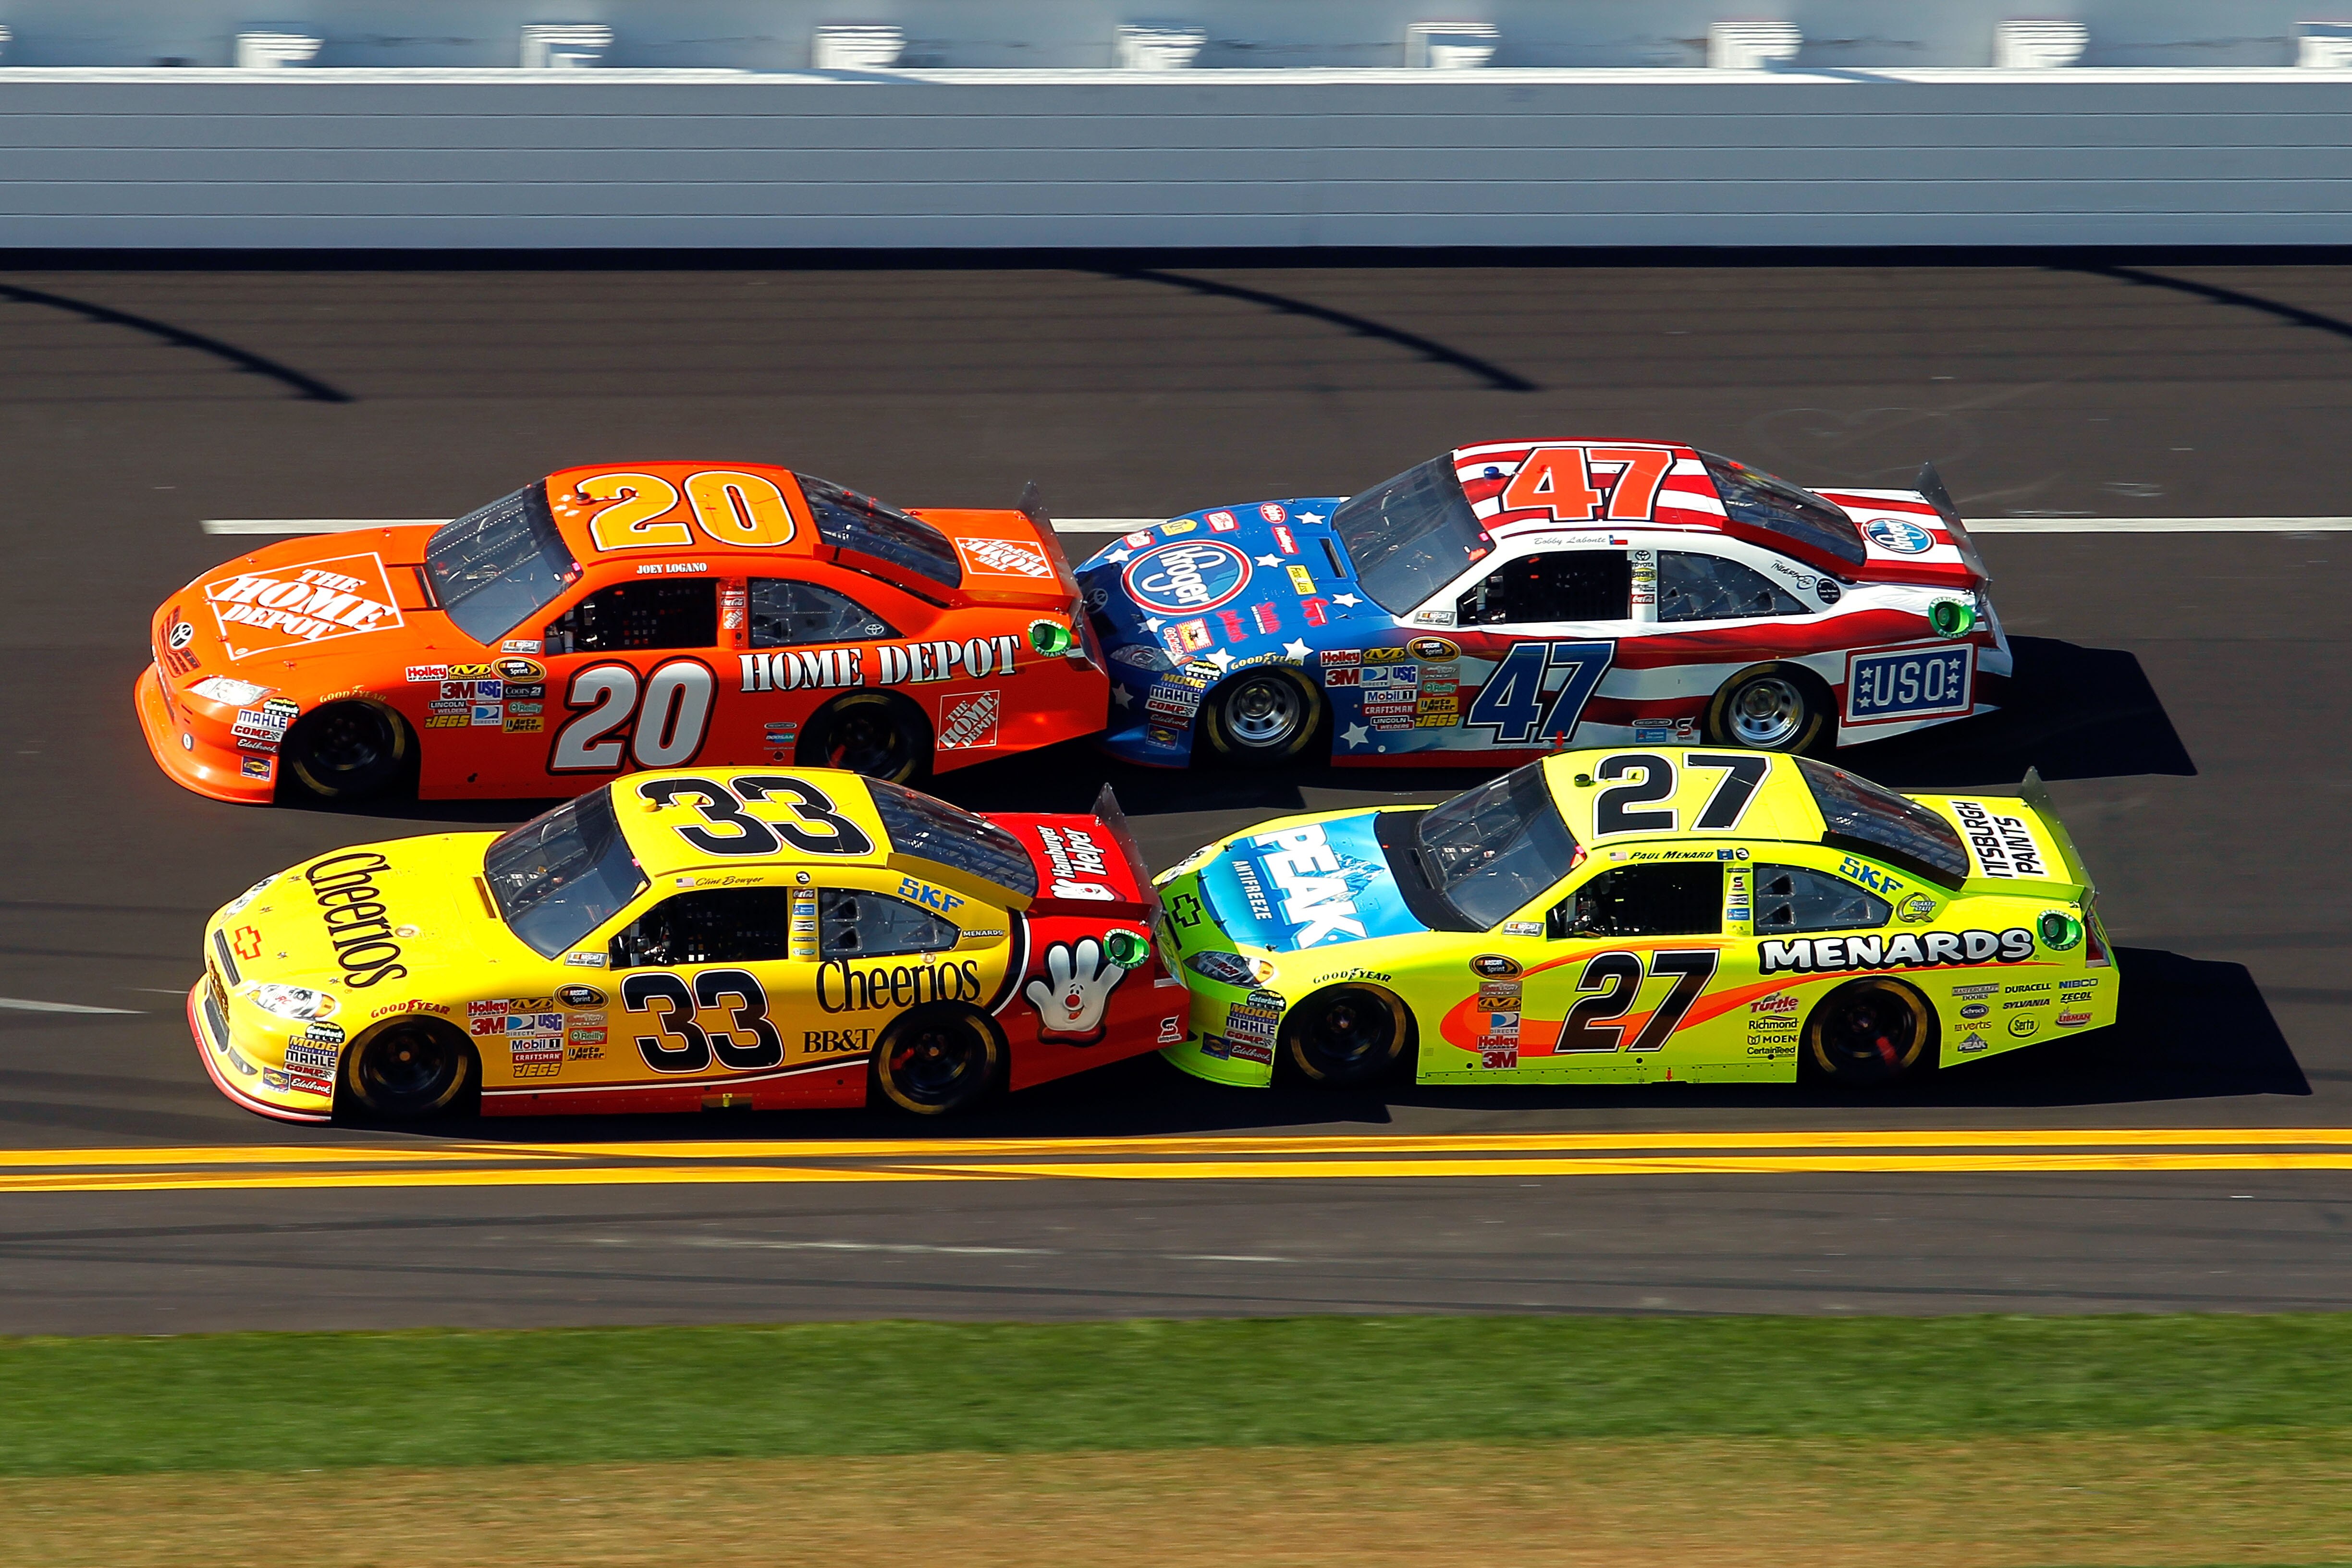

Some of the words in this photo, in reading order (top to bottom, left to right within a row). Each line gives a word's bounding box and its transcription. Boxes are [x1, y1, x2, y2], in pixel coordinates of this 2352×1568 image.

[1500, 447, 1677, 522] 47
[576, 471, 796, 551] 20
[1534, 538, 1562, 546] Bobby
[1875, 520, 1924, 551] Kroger
[960, 539, 1049, 576] HOME
[988, 540, 1044, 563] DEPOT
[637, 564, 664, 575] JOEY
[665, 563, 708, 574] LOGANO
[974, 555, 1009, 572] THE
[294, 569, 367, 593] THE
[1141, 546, 1227, 604] Kroger
[215, 576, 397, 631] HOME
[1930, 597, 1966, 609] AMERICAN
[220, 604, 335, 640] DEPOT
[1027, 619, 1063, 633] AMERICAN
[738, 647, 863, 692] HOME
[877, 635, 1019, 685] DEPOT
[1231, 654, 1302, 670] GOODYEAR
[1322, 651, 1360, 664] Holley
[407, 666, 447, 679] Holley
[1161, 673, 1207, 688] MOOG
[1327, 668, 1359, 686] 3M
[1392, 666, 1416, 683] USG
[441, 682, 475, 699] 3M
[478, 681, 501, 697] USG
[1424, 683, 1456, 693] O'Reilly
[1874, 659, 1946, 707] USO
[319, 689, 387, 703] GOODYEAR
[1152, 686, 1200, 704] MAHLE
[1368, 691, 1400, 701] Mobil
[1467, 640, 1617, 743] 47
[509, 702, 543, 713] O'Reilly
[946, 700, 969, 722] THE
[1148, 700, 1186, 713] COMP
[1365, 706, 1413, 714] CRAFTSMAN
[239, 710, 286, 728] MAHLE
[426, 715, 469, 727] JEGS
[551, 661, 716, 770] 20
[939, 691, 1000, 749] HOME
[1150, 713, 1188, 728] Edelbrock
[1417, 714, 1459, 727] JEGS
[234, 725, 271, 737] COMP
[961, 710, 998, 748] DEPOT
[237, 738, 277, 753] Edelbrock
[1593, 752, 1772, 839] 27
[636, 774, 875, 856] 33
[1951, 801, 2013, 877] ITTSBURGH
[1993, 816, 2044, 874] PAINTS
[1037, 825, 1076, 879] Hamburger
[1062, 827, 1107, 876] Helper
[1629, 852, 1660, 860] PAUL
[1662, 851, 1714, 859] MENARD
[1736, 849, 1749, 858] 3
[696, 878, 721, 886] Clint
[722, 876, 764, 885] Bowyer
[797, 873, 809, 882] 3
[1838, 856, 1904, 894] SKF
[1231, 860, 1272, 920] ANTIFREEZE
[1253, 823, 1370, 949] PEAK
[897, 877, 965, 913] SKF
[305, 852, 408, 988] Cheerios
[2038, 909, 2074, 922] AMERICAN
[1105, 928, 1141, 942] AMERICAN
[1760, 930, 2034, 973] MENARDS
[1109, 953, 1150, 969] ETHANOL
[1313, 968, 1391, 984] GOODYEAR
[2059, 978, 2098, 989] NIBCO
[816, 960, 980, 1014] Cheerios
[1953, 984, 1998, 994] MASTERCRAFT
[2005, 983, 2050, 993] DURACELL
[1249, 994, 1285, 1007] Gatorback
[1555, 950, 1719, 1053] 27
[1751, 996, 1798, 1013] Turtle
[2003, 999, 2050, 1009] SYLVANIA
[2061, 992, 2092, 1001] ZECOL
[370, 1000, 450, 1018] GOODYEAR
[468, 1000, 508, 1015] Holley
[1231, 1004, 1278, 1019] MOOG
[1961, 1007, 1985, 1015] Schrock
[538, 1014, 562, 1031] USG
[621, 969, 785, 1073] 33
[1749, 1018, 1797, 1029] Richmond
[1963, 1021, 1992, 1030] vertis
[2014, 1018, 2034, 1031] Serta
[2058, 1013, 2091, 1022] LIBMAN
[306, 1026, 344, 1039] Gatorback
[470, 1017, 505, 1036] 3M
[1226, 1017, 1275, 1035] MAHLE
[307, 1034, 342, 1043] BELTS
[571, 1030, 604, 1041] O'Reilly
[802, 1029, 875, 1054] BB&T
[1226, 1030, 1263, 1042] COMP
[1479, 1036, 1518, 1049] Holley
[1763, 1035, 1797, 1043] MOEN
[290, 1037, 337, 1051] MOOG
[512, 1040, 546, 1050] Mobil
[1747, 1046, 1796, 1054] CertainTeed
[1959, 1041, 1987, 1050] PEAK
[286, 1050, 335, 1068] MAHLE
[515, 1053, 560, 1061] CRAFTSMAN
[1232, 1045, 1270, 1061] Edelbrock
[1482, 1051, 1517, 1069] 3M
[286, 1064, 324, 1076] COMP
[516, 1063, 562, 1077] JEGS
[291, 1078, 331, 1094] Edelbrock
